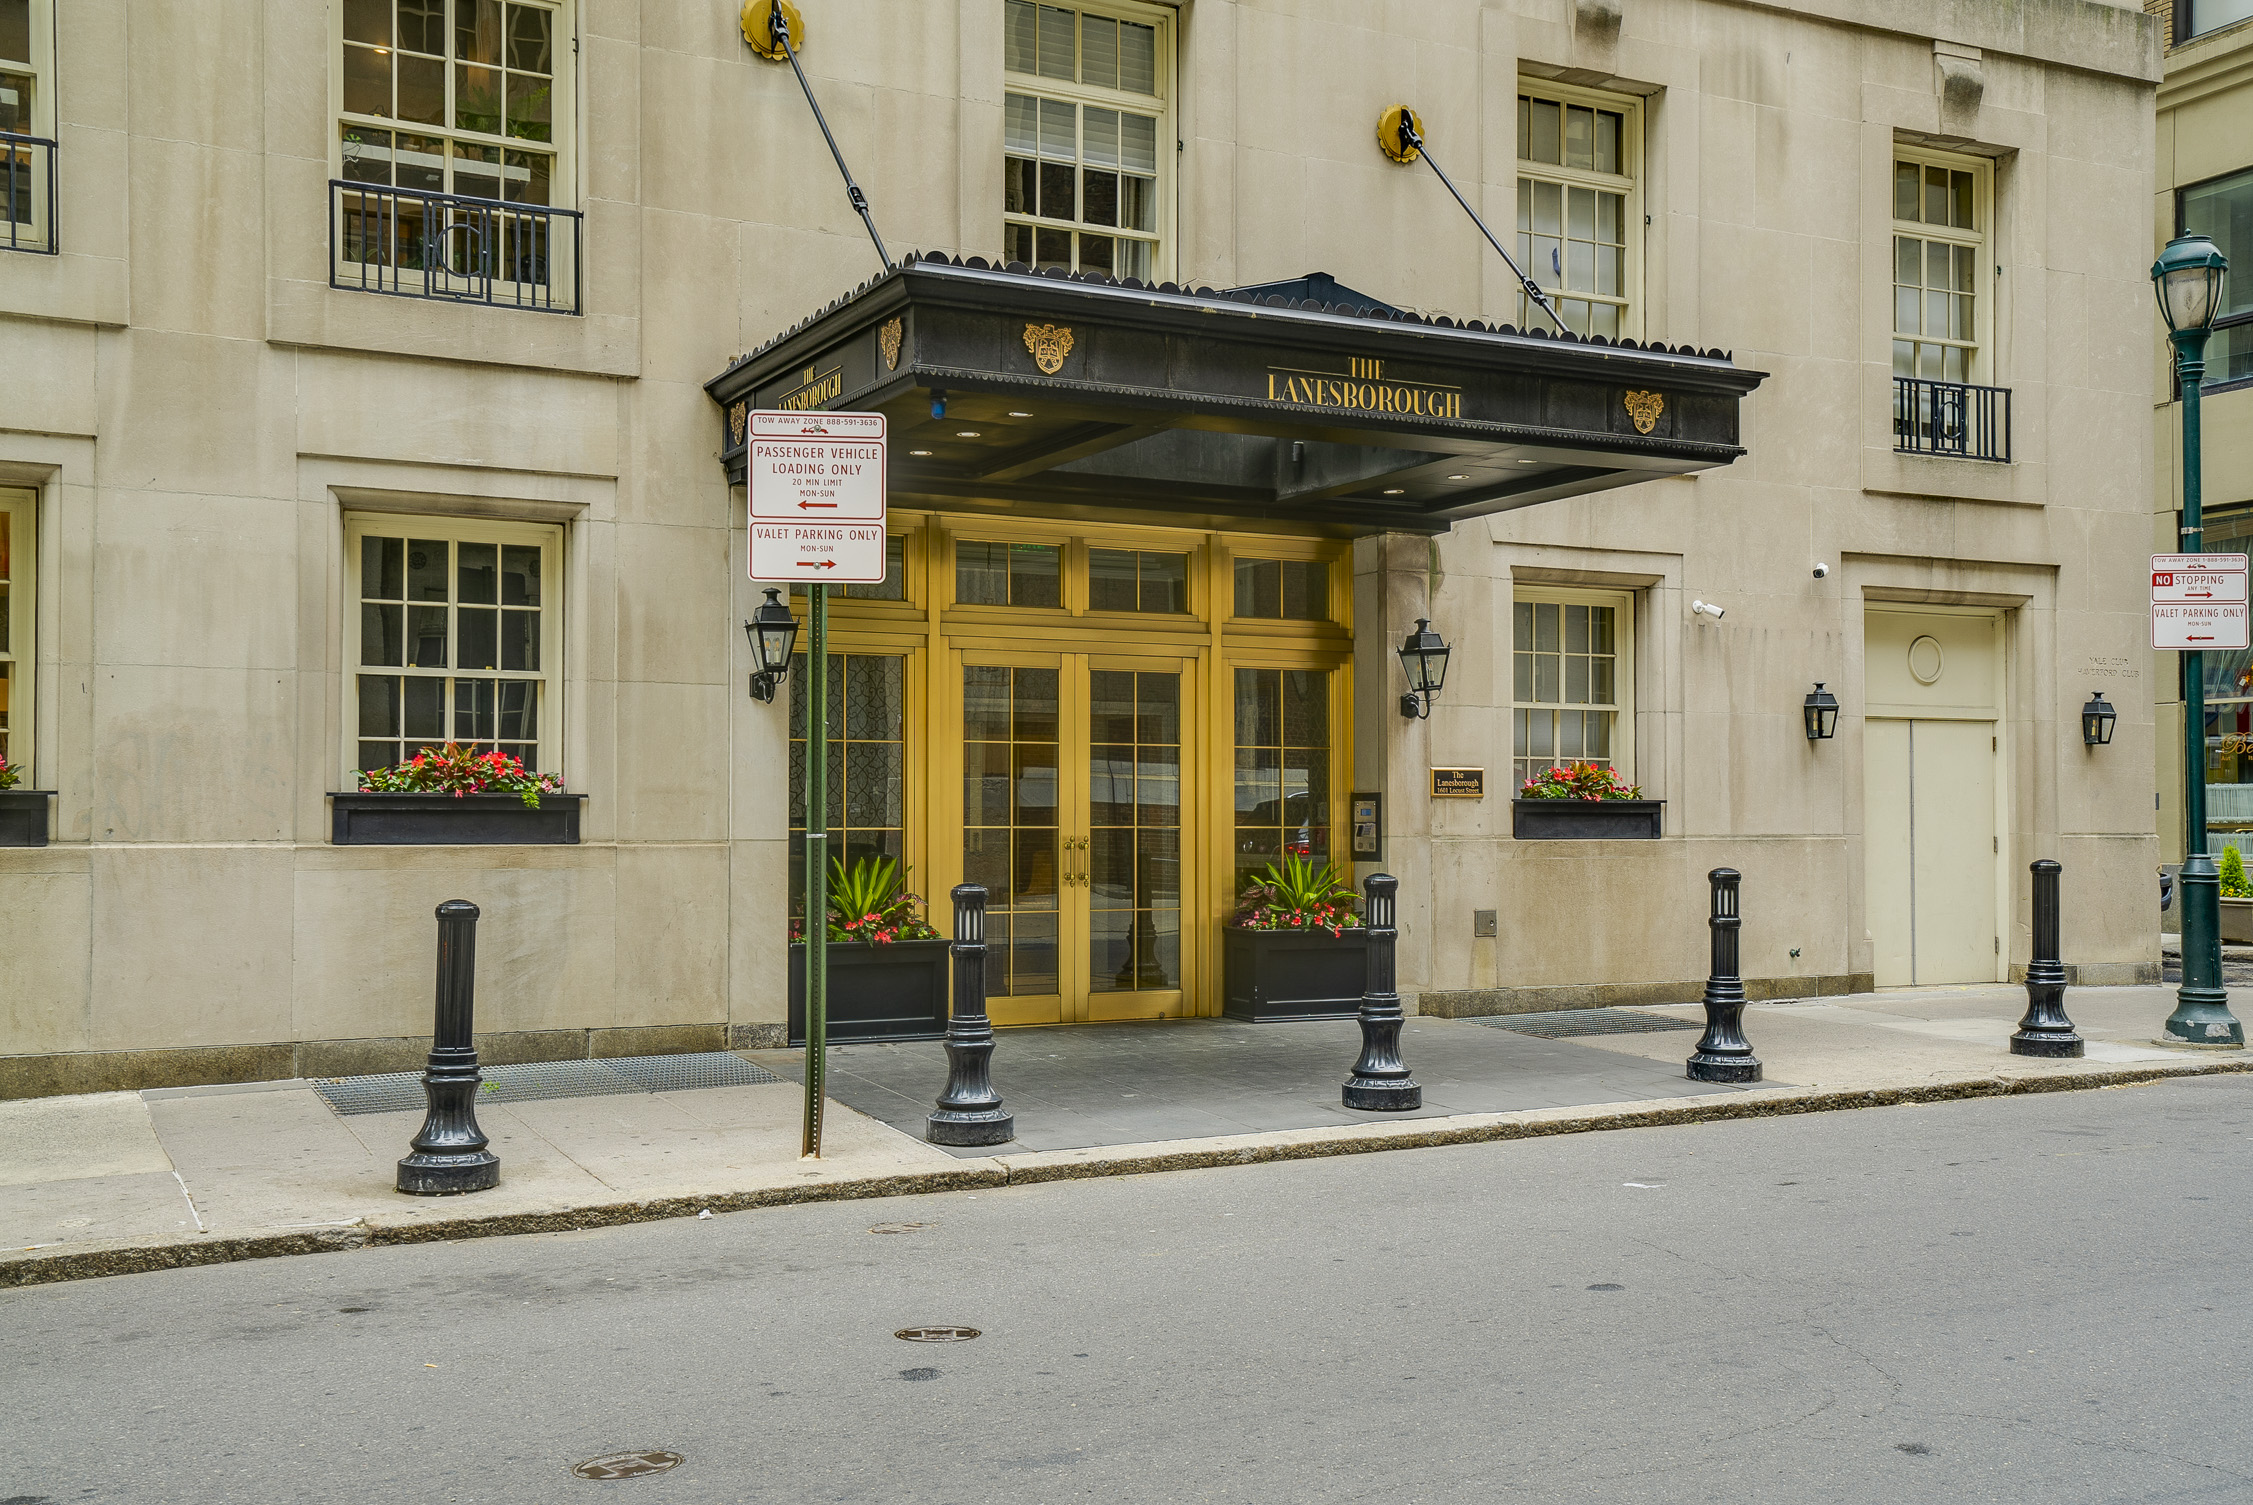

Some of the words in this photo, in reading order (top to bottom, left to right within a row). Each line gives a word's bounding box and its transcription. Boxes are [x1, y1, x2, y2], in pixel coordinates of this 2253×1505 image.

[1348, 356, 1385, 380] THE
[803, 365, 815, 386] THE
[1267, 373, 1461, 418] LANESBOROUGH
[778, 417, 801, 425] AWAY
[757, 446, 825, 459] PASSENGER
[831, 447, 878, 460] VEHICLE
[772, 462, 825, 475] LOADING
[831, 464, 862, 476] ONLY
[792, 478, 802, 486] 20
[805, 478, 820, 486] MIN
[823, 479, 843, 487] LIMIT
[799, 489, 835, 498] MON-SUN
[757, 528, 789, 539] VALET
[795, 529, 843, 540] PARKING
[849, 529, 878, 541] ONLY
[2155, 575, 2170, 585] NO
[2175, 575, 2224, 585] STOPPING
[2155, 608, 2178, 618] VALET
[2183, 608, 2219, 618] PARKING
[2223, 608, 2244, 618] ONLY
[1452, 771, 1465, 779] The
[1437, 779, 1479, 788] Lanesborough
